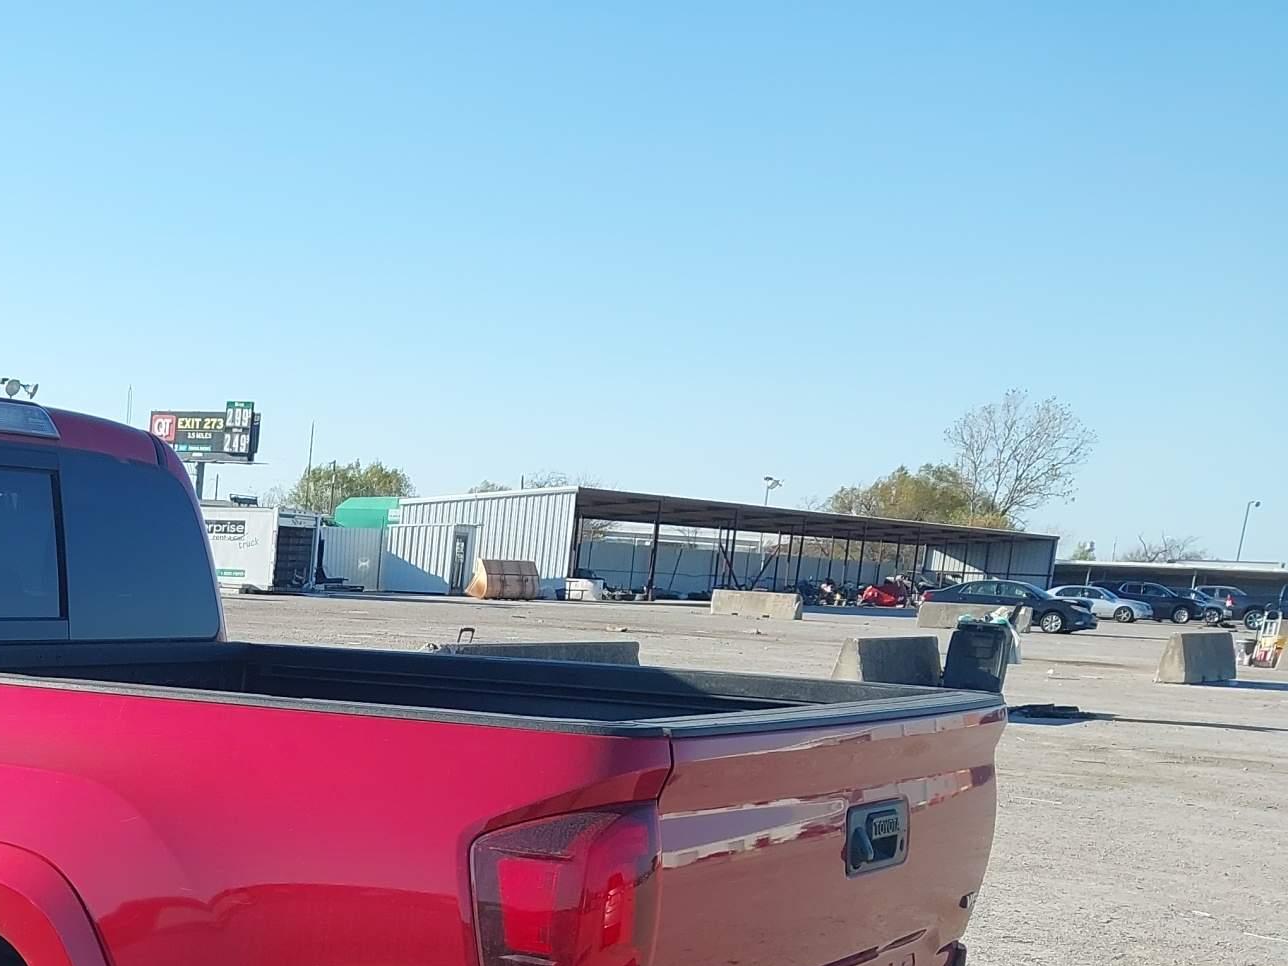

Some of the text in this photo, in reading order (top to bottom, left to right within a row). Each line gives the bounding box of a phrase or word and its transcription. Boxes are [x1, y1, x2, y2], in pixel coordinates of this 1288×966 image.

[154, 418, 172, 437] QT
[177, 418, 224, 430] EXIT 273
